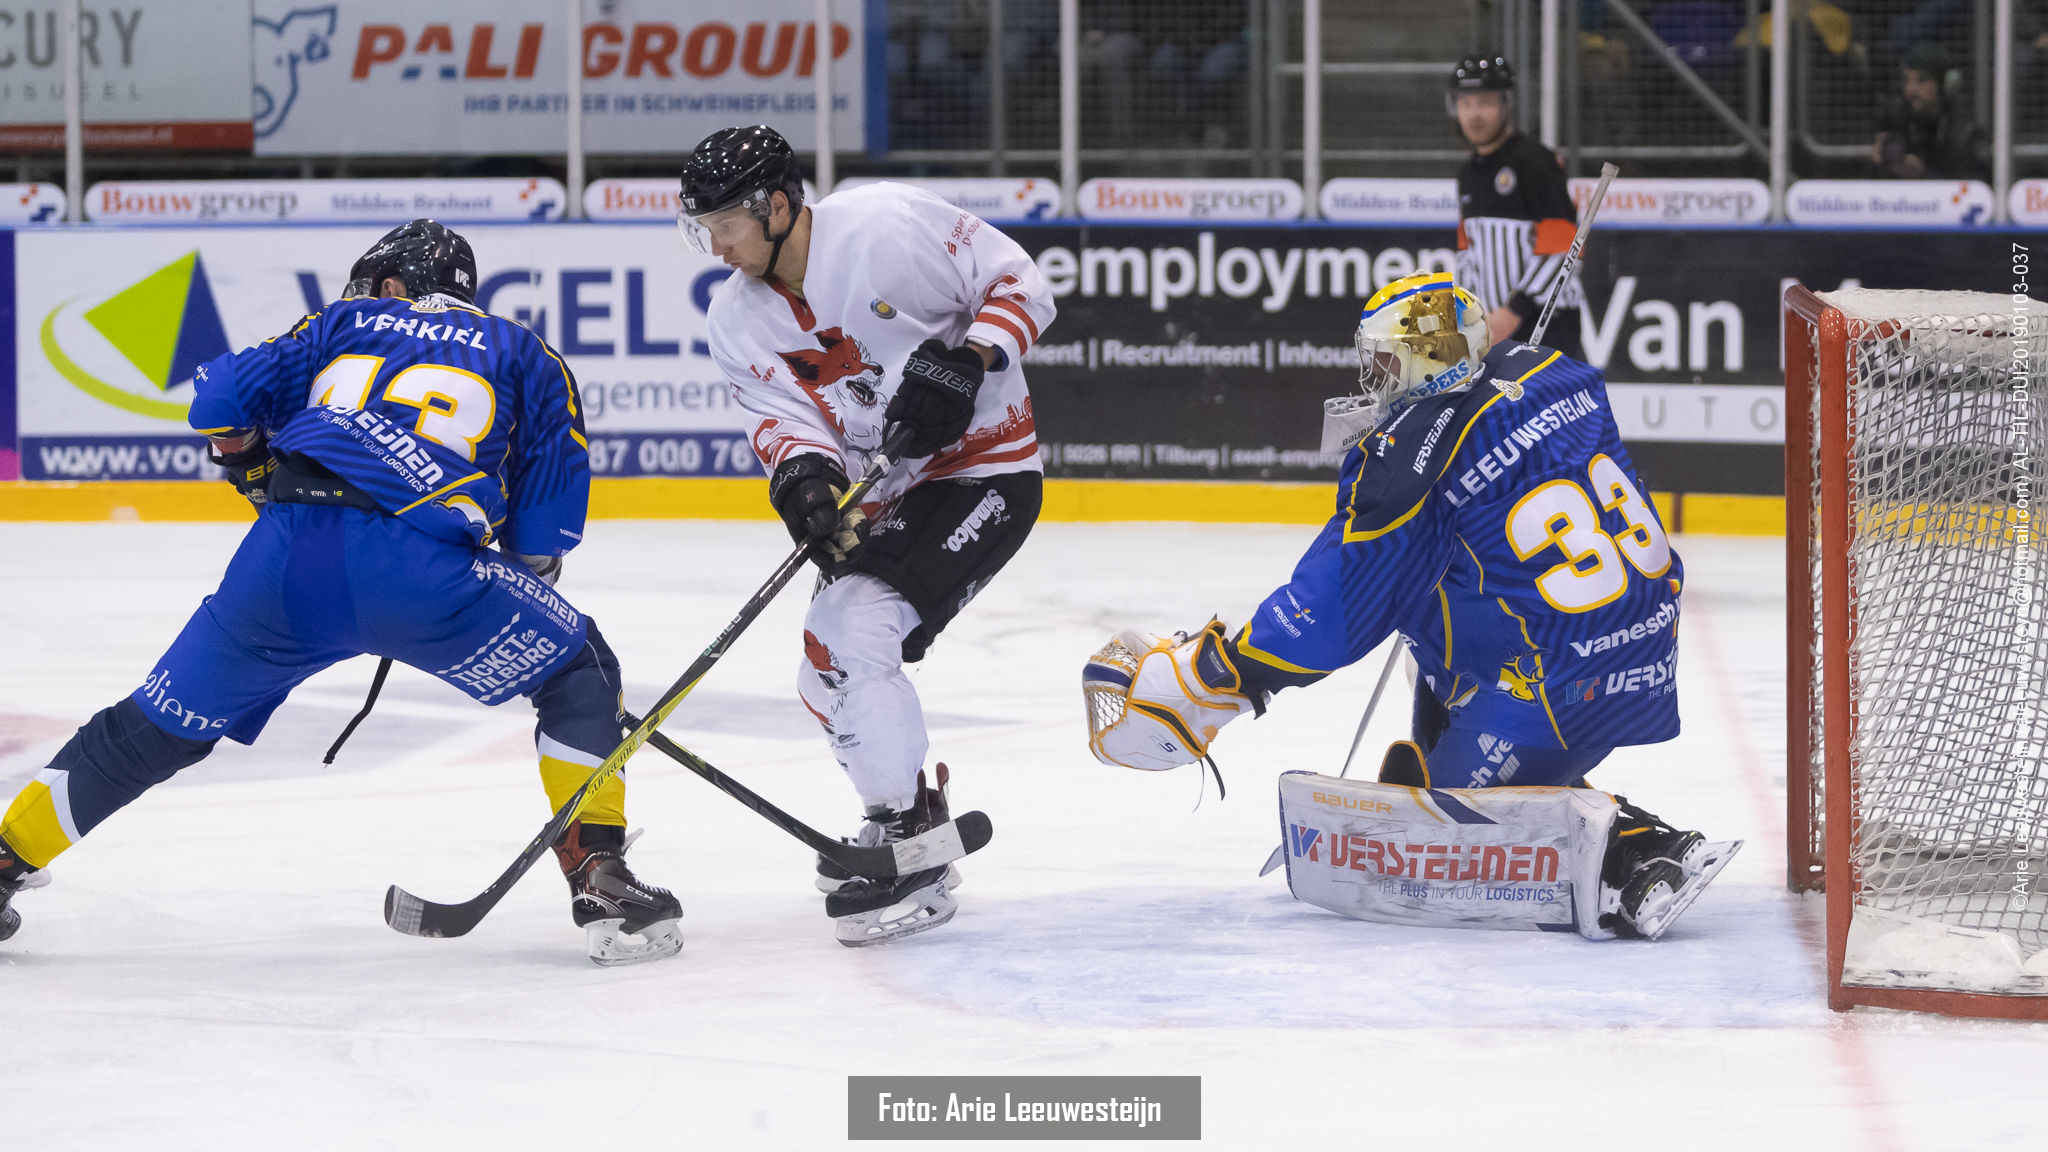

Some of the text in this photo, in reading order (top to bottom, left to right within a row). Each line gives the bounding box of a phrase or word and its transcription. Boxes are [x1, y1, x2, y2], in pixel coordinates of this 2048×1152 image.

[352, 22, 852, 80] PALI GROUP
[507, 94, 608, 113] PARTER
[640, 93, 849, 113] SCHWEINEFLEISH
[101, 188, 298, 217] Bouwgroep
[1096, 184, 1287, 216] Bouwgroep
[1036, 233, 1458, 312] employmen
[355, 311, 487, 351] VERKIEL
[1578, 275, 1744, 371] Van
[1103, 341, 1260, 368] Recruitment
[1641, 395, 1779, 431] UTO
[638, 440, 703, 473] 000
[711, 440, 753, 473] 76
[1412, 407, 1455, 475] VERSTEIJNEN
[1444, 389, 1599, 508] LEEUWESTEIJN
[382, 454, 425, 493] LOGISTICS
[1505, 453, 1672, 613] 33
[456, 633, 528, 684] TICKET
[466, 637, 558, 693] TILBURG
[1605, 644, 1677, 695] VERST
[1312, 791, 1393, 814] BAUER
[1330, 832, 1560, 883] VERSTEIJNEN
[1379, 881, 1555, 902] THE PLUS IN YOUR LOGISTICS
